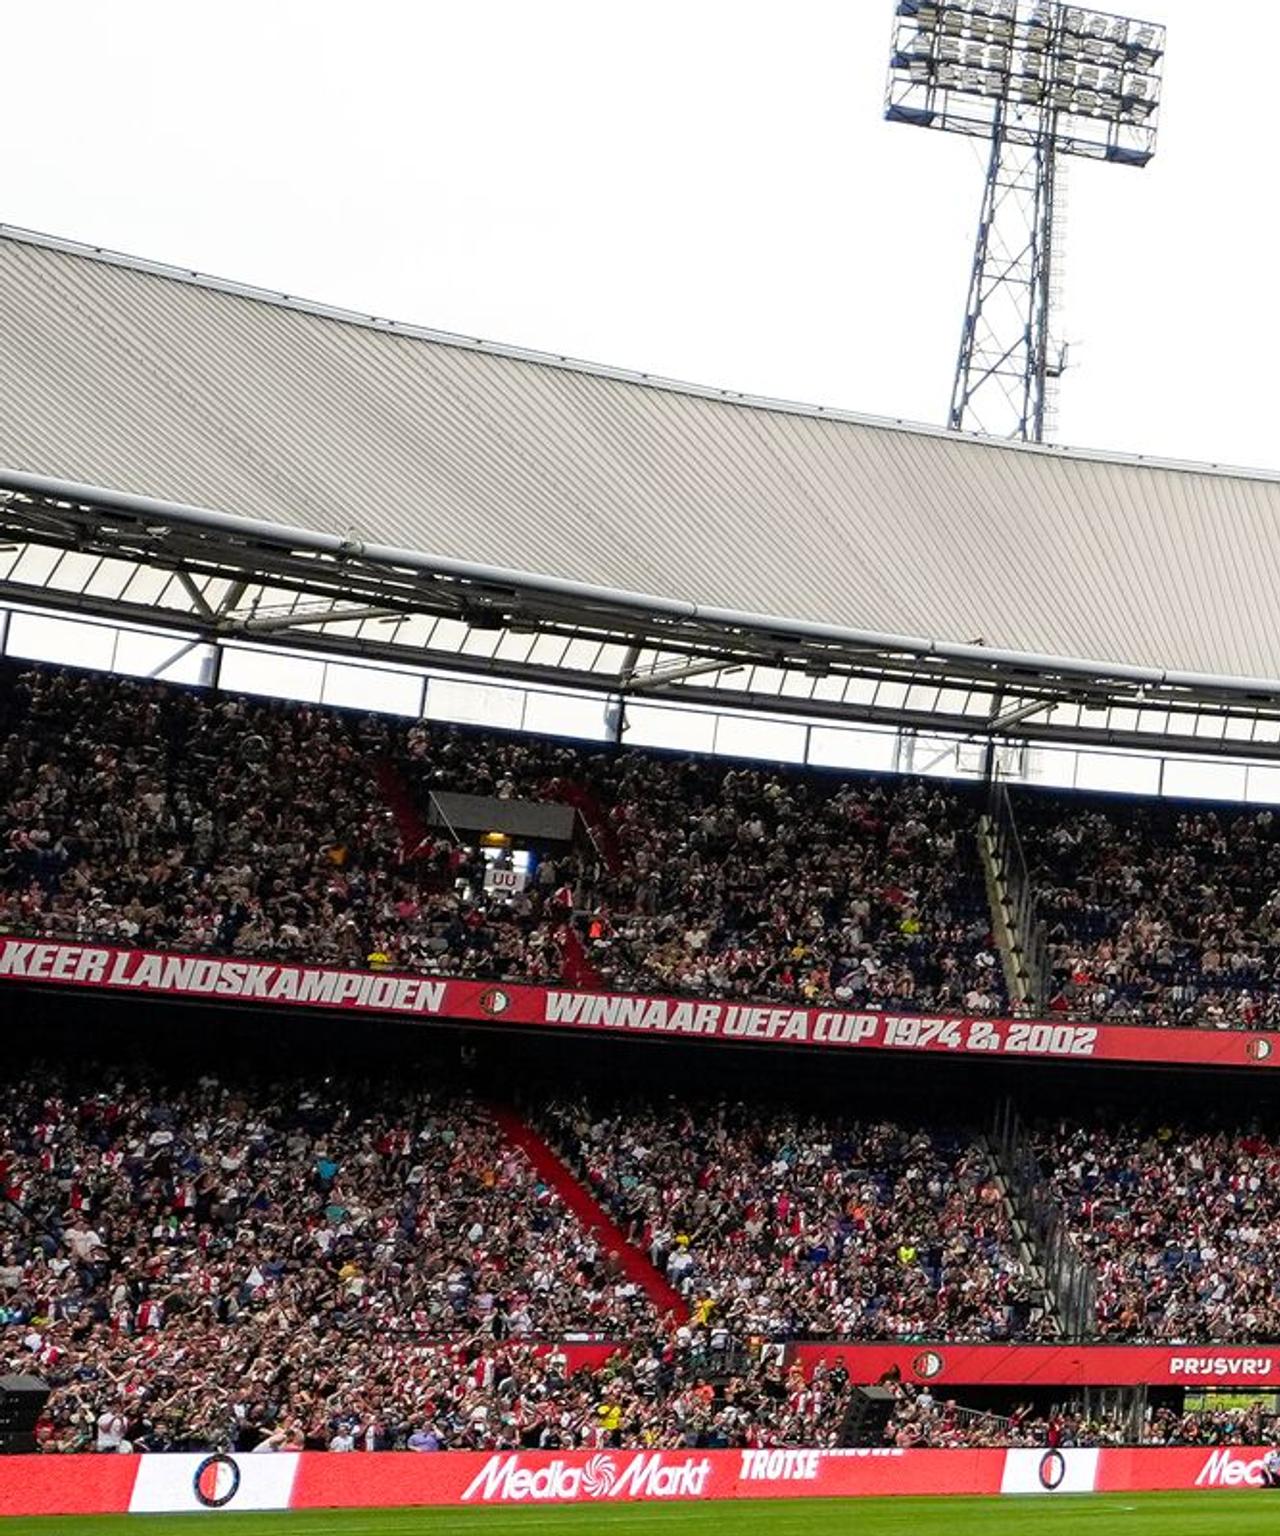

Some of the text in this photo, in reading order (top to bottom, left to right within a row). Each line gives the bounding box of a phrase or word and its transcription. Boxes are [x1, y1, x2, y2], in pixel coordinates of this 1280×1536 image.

[0, 940, 446, 1012] KEER LANDSKAMPIOEN
[545, 992, 1098, 1055] WINNAAR UEFA CUP 1974 & 2002
[739, 1450, 820, 1480] TROTSE
